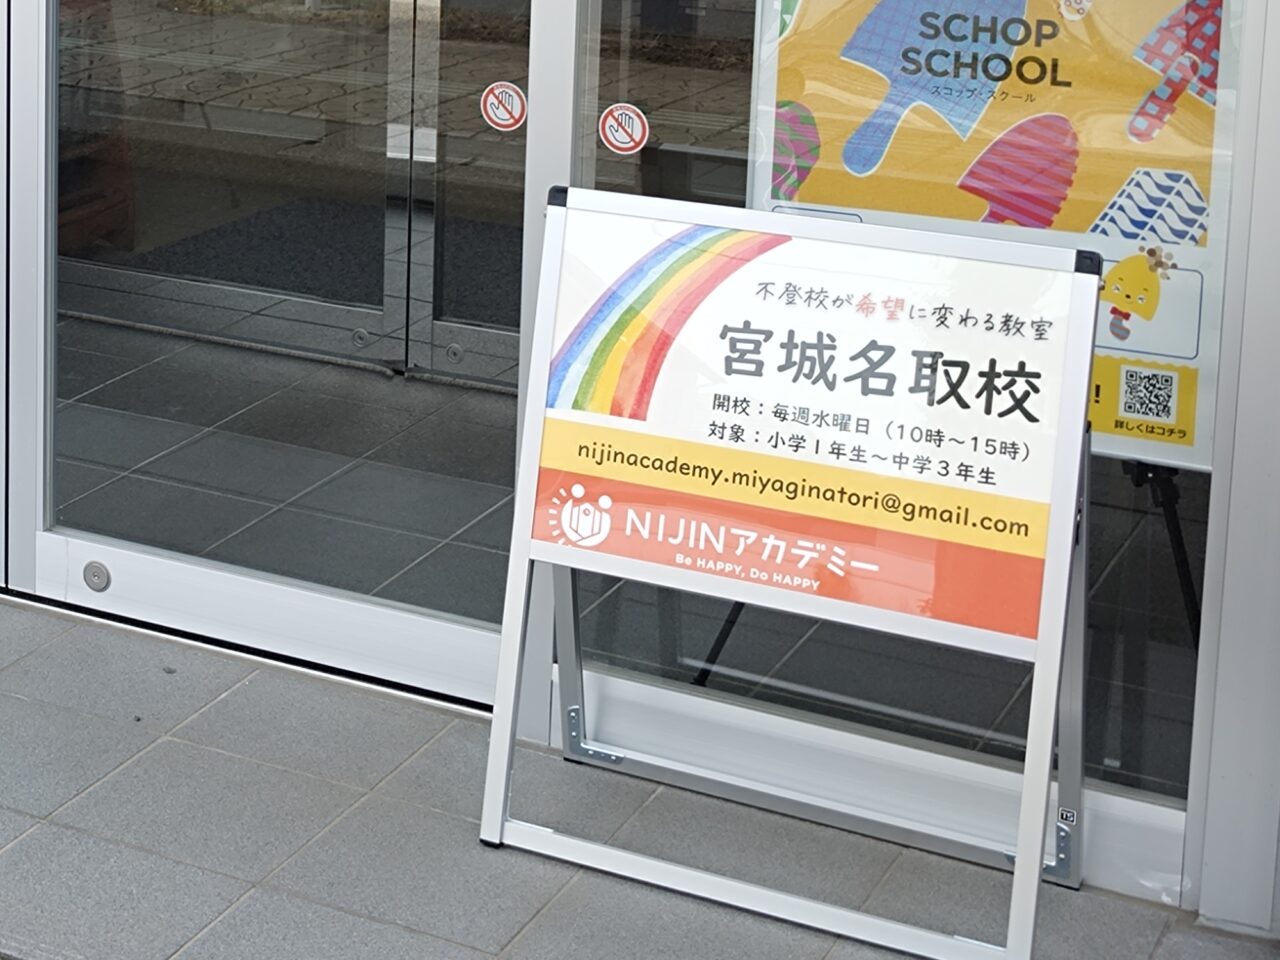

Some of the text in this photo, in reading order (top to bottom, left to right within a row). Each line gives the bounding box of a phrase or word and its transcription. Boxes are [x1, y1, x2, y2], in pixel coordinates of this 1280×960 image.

[918, 11, 1060, 48] SCHOP
[899, 47, 1072, 88] SCHOOL
[930, 85, 1036, 104] スコップ・スクール
[756, 281, 1053, 341] 不登校が希望に変わる教室
[720, 320, 1041, 423] 宮城名取校
[1114, 420, 1187, 439] 詳しくはコチラ
[577, 442, 1030, 538] nijinacademy.miyaginatori@gmail.com
[625, 508, 880, 577] NIJINアカデミー
[675, 553, 820, 591] Be HAPPY, Do HAPPY
